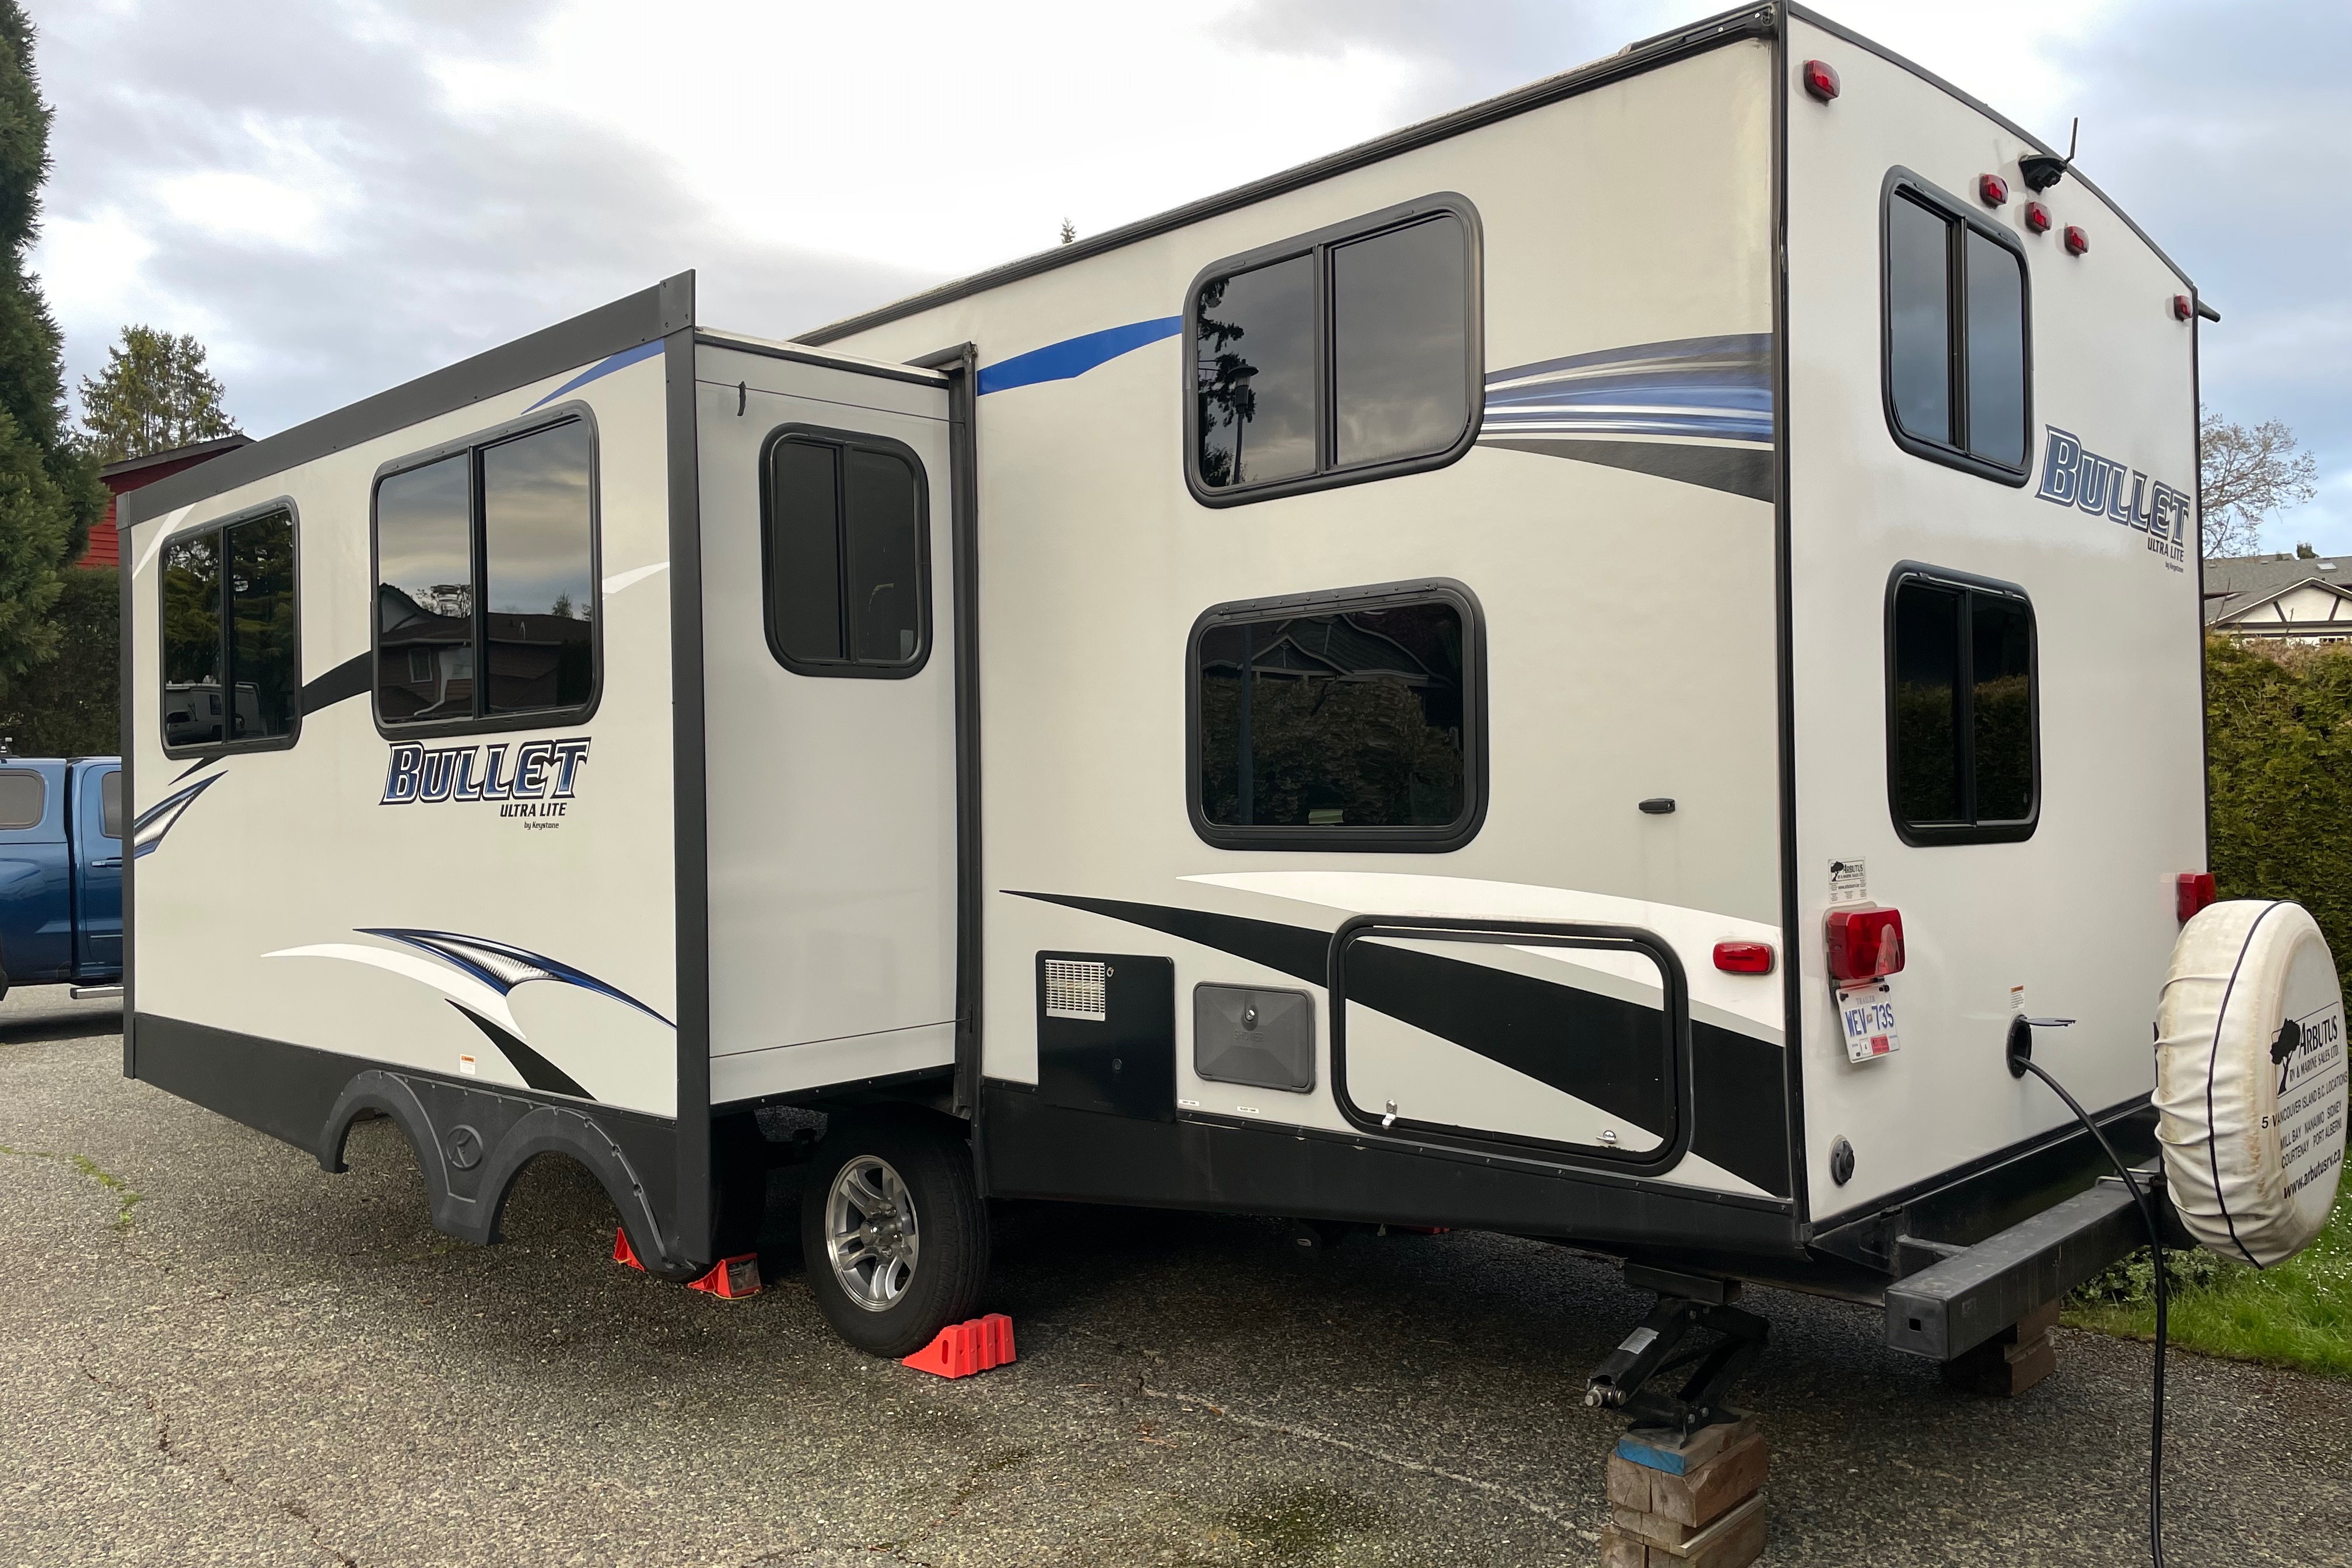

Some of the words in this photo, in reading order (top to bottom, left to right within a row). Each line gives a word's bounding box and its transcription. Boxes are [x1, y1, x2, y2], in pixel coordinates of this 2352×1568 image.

[2035, 424, 2191, 548] BULLET
[2147, 537, 2169, 557] ULTRA
[2170, 545, 2185, 563] LITE
[379, 736, 592, 806] BULLET
[500, 803, 536, 817] ULTRA
[539, 802, 568, 817] LITE
[524, 821, 531, 831] by
[532, 821, 559, 831] Keystone
[1845, 1007, 1867, 1037] WEV
[1871, 1003, 1894, 1031] 73S
[1856, 995, 1876, 1005] TRAILER
[2298, 1015, 2337, 1059] ARBUTUS
[2301, 1055, 2317, 1076] MARINE
[2318, 1049, 2330, 1066] SALES
[2330, 1044, 2340, 1059] LTD.
[2262, 1116, 2269, 1129] 5
[2272, 1099, 2302, 1127] VANCOUVER
[2302, 1090, 2317, 1110] ISLAND
[2326, 1071, 2348, 1094] LOCATIONS
[2280, 1133, 2292, 1152] MILL
[2292, 1125, 2302, 1143] BAY
[2304, 1111, 2325, 1135] NANAIMO
[2327, 1099, 2342, 1119] SIDNEY
[2281, 1138, 2309, 1169] COURTENAY
[2313, 1129, 2325, 1148] PORT
[2325, 1116, 2342, 1140] ALBERNI
[2284, 1149, 2342, 1199] www.arbutusrv.ca
